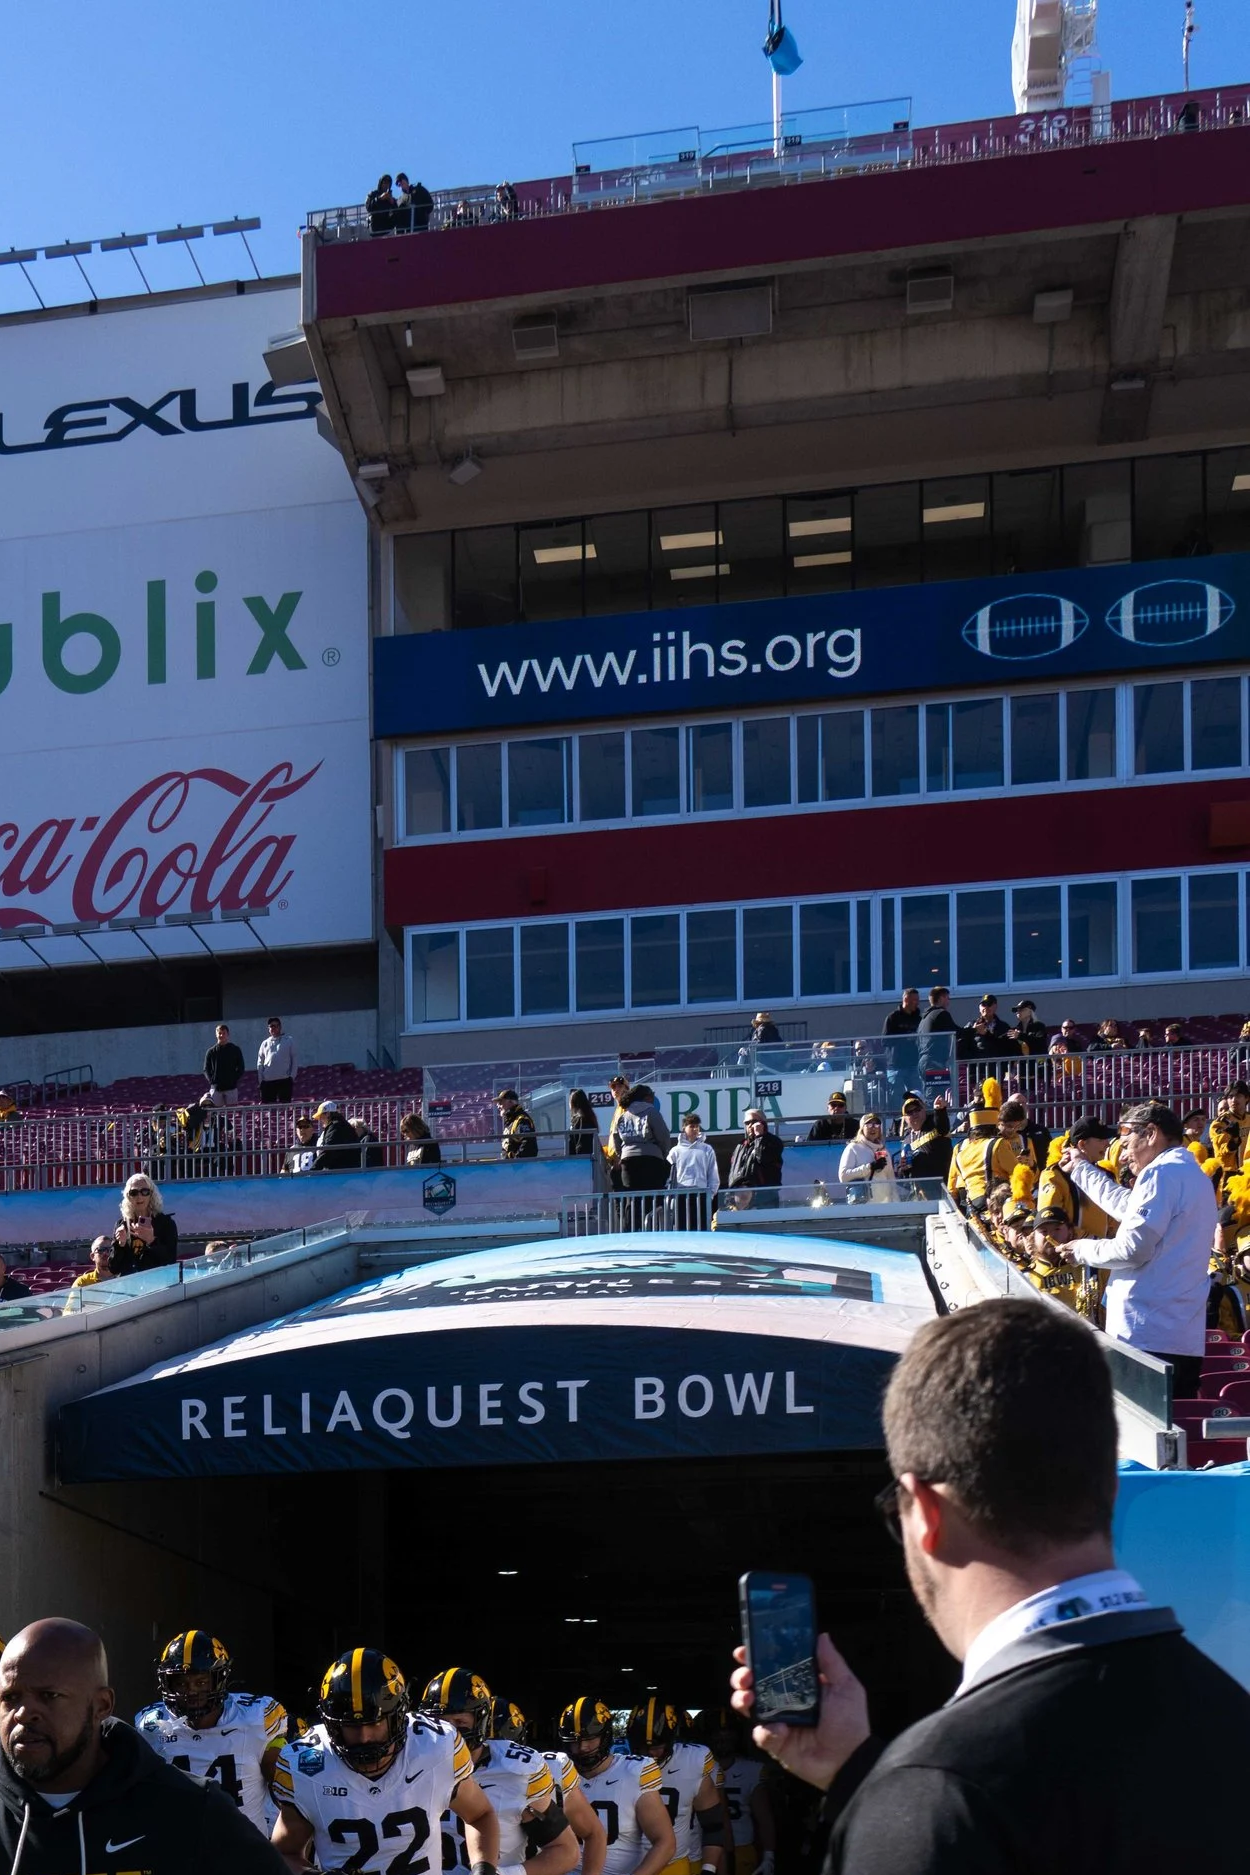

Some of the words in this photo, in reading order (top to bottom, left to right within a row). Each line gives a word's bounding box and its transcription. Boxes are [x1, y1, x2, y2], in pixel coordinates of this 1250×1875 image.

[478, 627, 862, 698] www.iihs.org
[591, 1093, 612, 1103] 219
[757, 1083, 779, 1092] 218
[292, 1151, 314, 1173] 18
[180, 1379, 590, 1440] RELIAQUEST
[635, 1370, 816, 1420] BOWL
